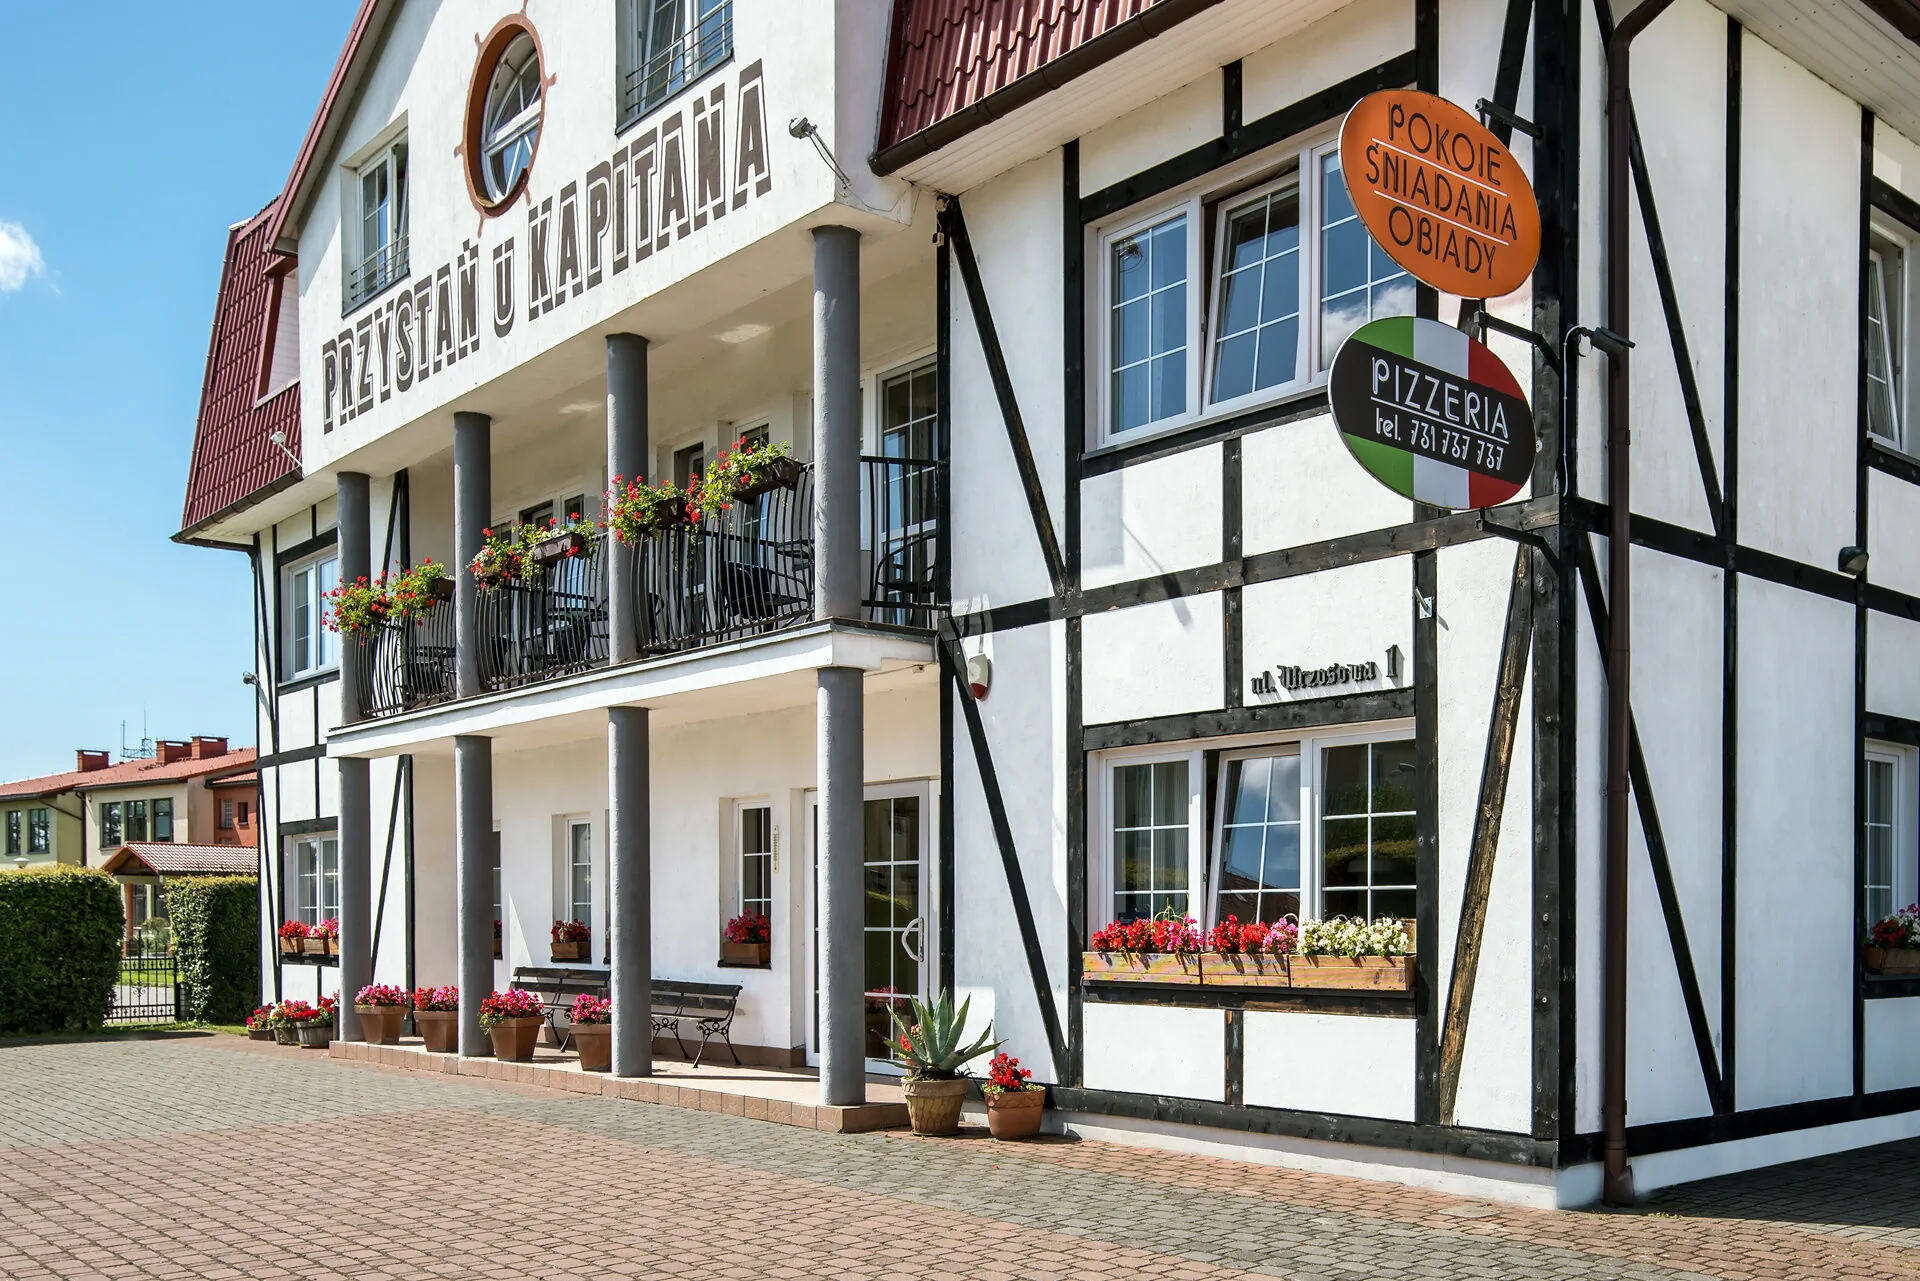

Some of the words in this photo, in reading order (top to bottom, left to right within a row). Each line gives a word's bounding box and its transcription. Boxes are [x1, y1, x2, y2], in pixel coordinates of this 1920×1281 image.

[1388, 102, 1501, 186] POKOJE
[1365, 143, 1517, 240] ŚNIADANIA
[322, 238, 480, 435] PRZYSTAŃ
[492, 236, 515, 339] U
[528, 58, 772, 321] KAPITANA
[1388, 206, 1496, 279] OBIADY
[1371, 356, 1509, 439] PIZZERIA
[1376, 407, 1402, 441] tel.
[1411, 419, 1436, 452] 731
[1442, 428, 1470, 461] 737
[1476, 439, 1504, 471] 737
[1251, 670, 1277, 694] ul.
[1385, 644, 1398, 677] 1
